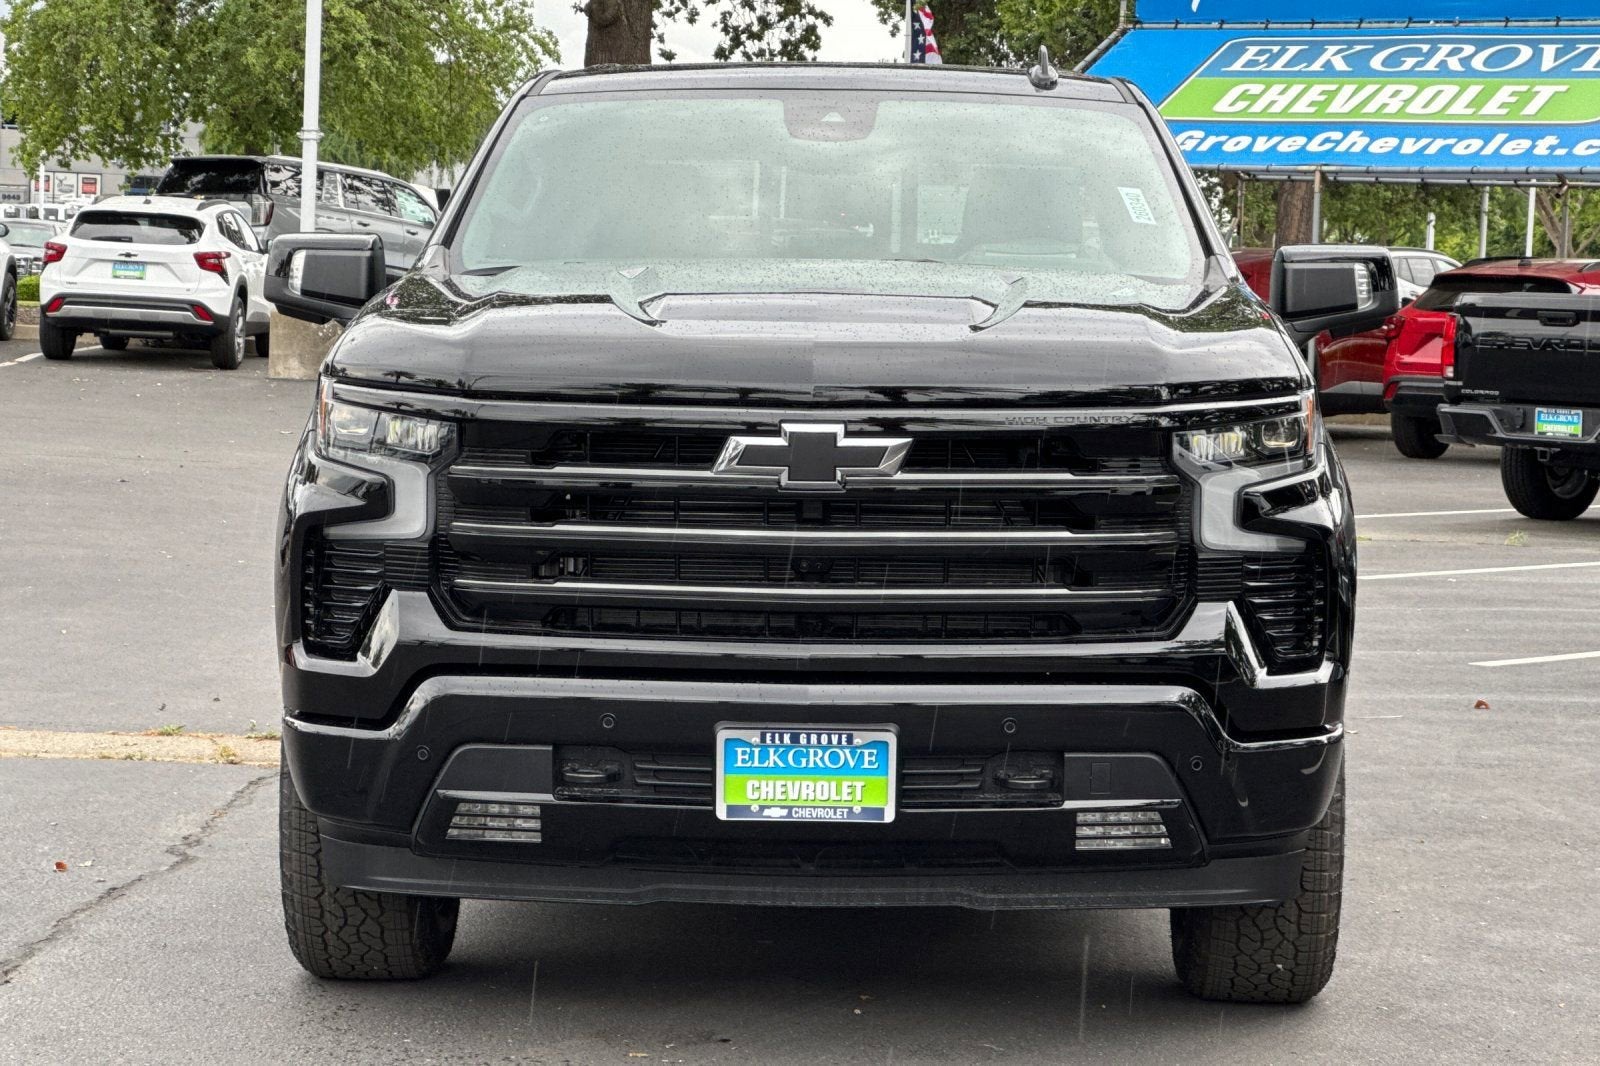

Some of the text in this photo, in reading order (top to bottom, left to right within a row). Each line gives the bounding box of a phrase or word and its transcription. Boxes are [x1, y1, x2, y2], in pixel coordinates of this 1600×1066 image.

[1221, 44, 1373, 71] ELK
[1212, 83, 1569, 116] CHEVROLET
[1004, 415, 1136, 425] HIGH COUNTRY
[1554, 413, 1579, 422] GROVE
[765, 732, 848, 745] ELK GROVE
[733, 747, 879, 769] ELK GROVE
[746, 779, 865, 802] CHEVROLET
[791, 807, 849, 819] CHEVROLET
